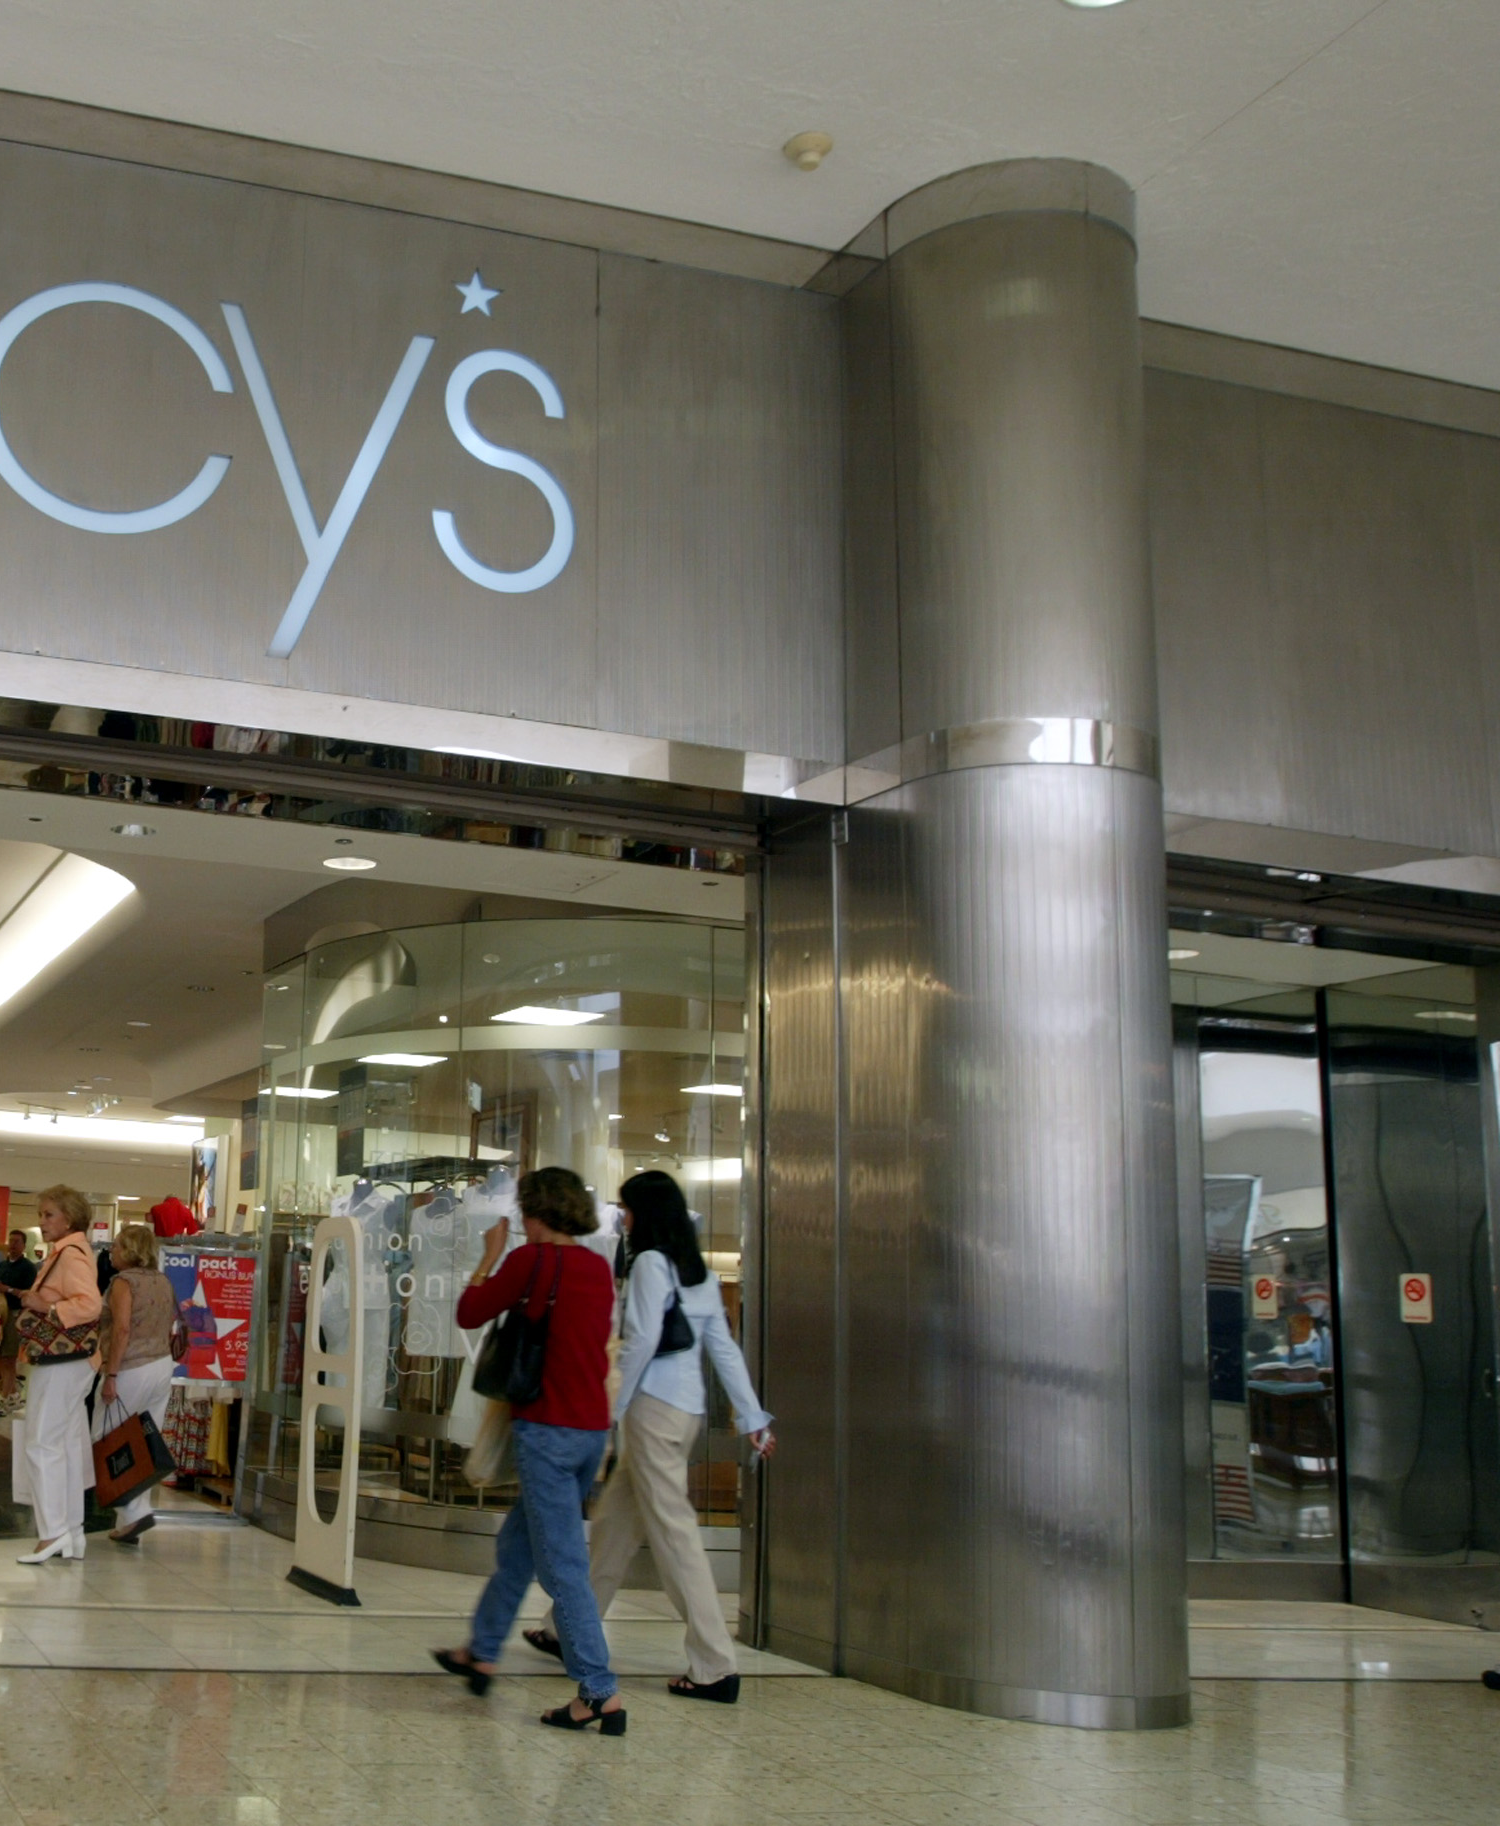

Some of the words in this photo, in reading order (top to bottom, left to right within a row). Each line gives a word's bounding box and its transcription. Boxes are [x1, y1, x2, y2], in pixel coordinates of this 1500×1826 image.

[198, 1256, 238, 1272] pack
[204, 1269, 237, 1281] BONUS
[225, 1339, 249, 1352] 5.95
